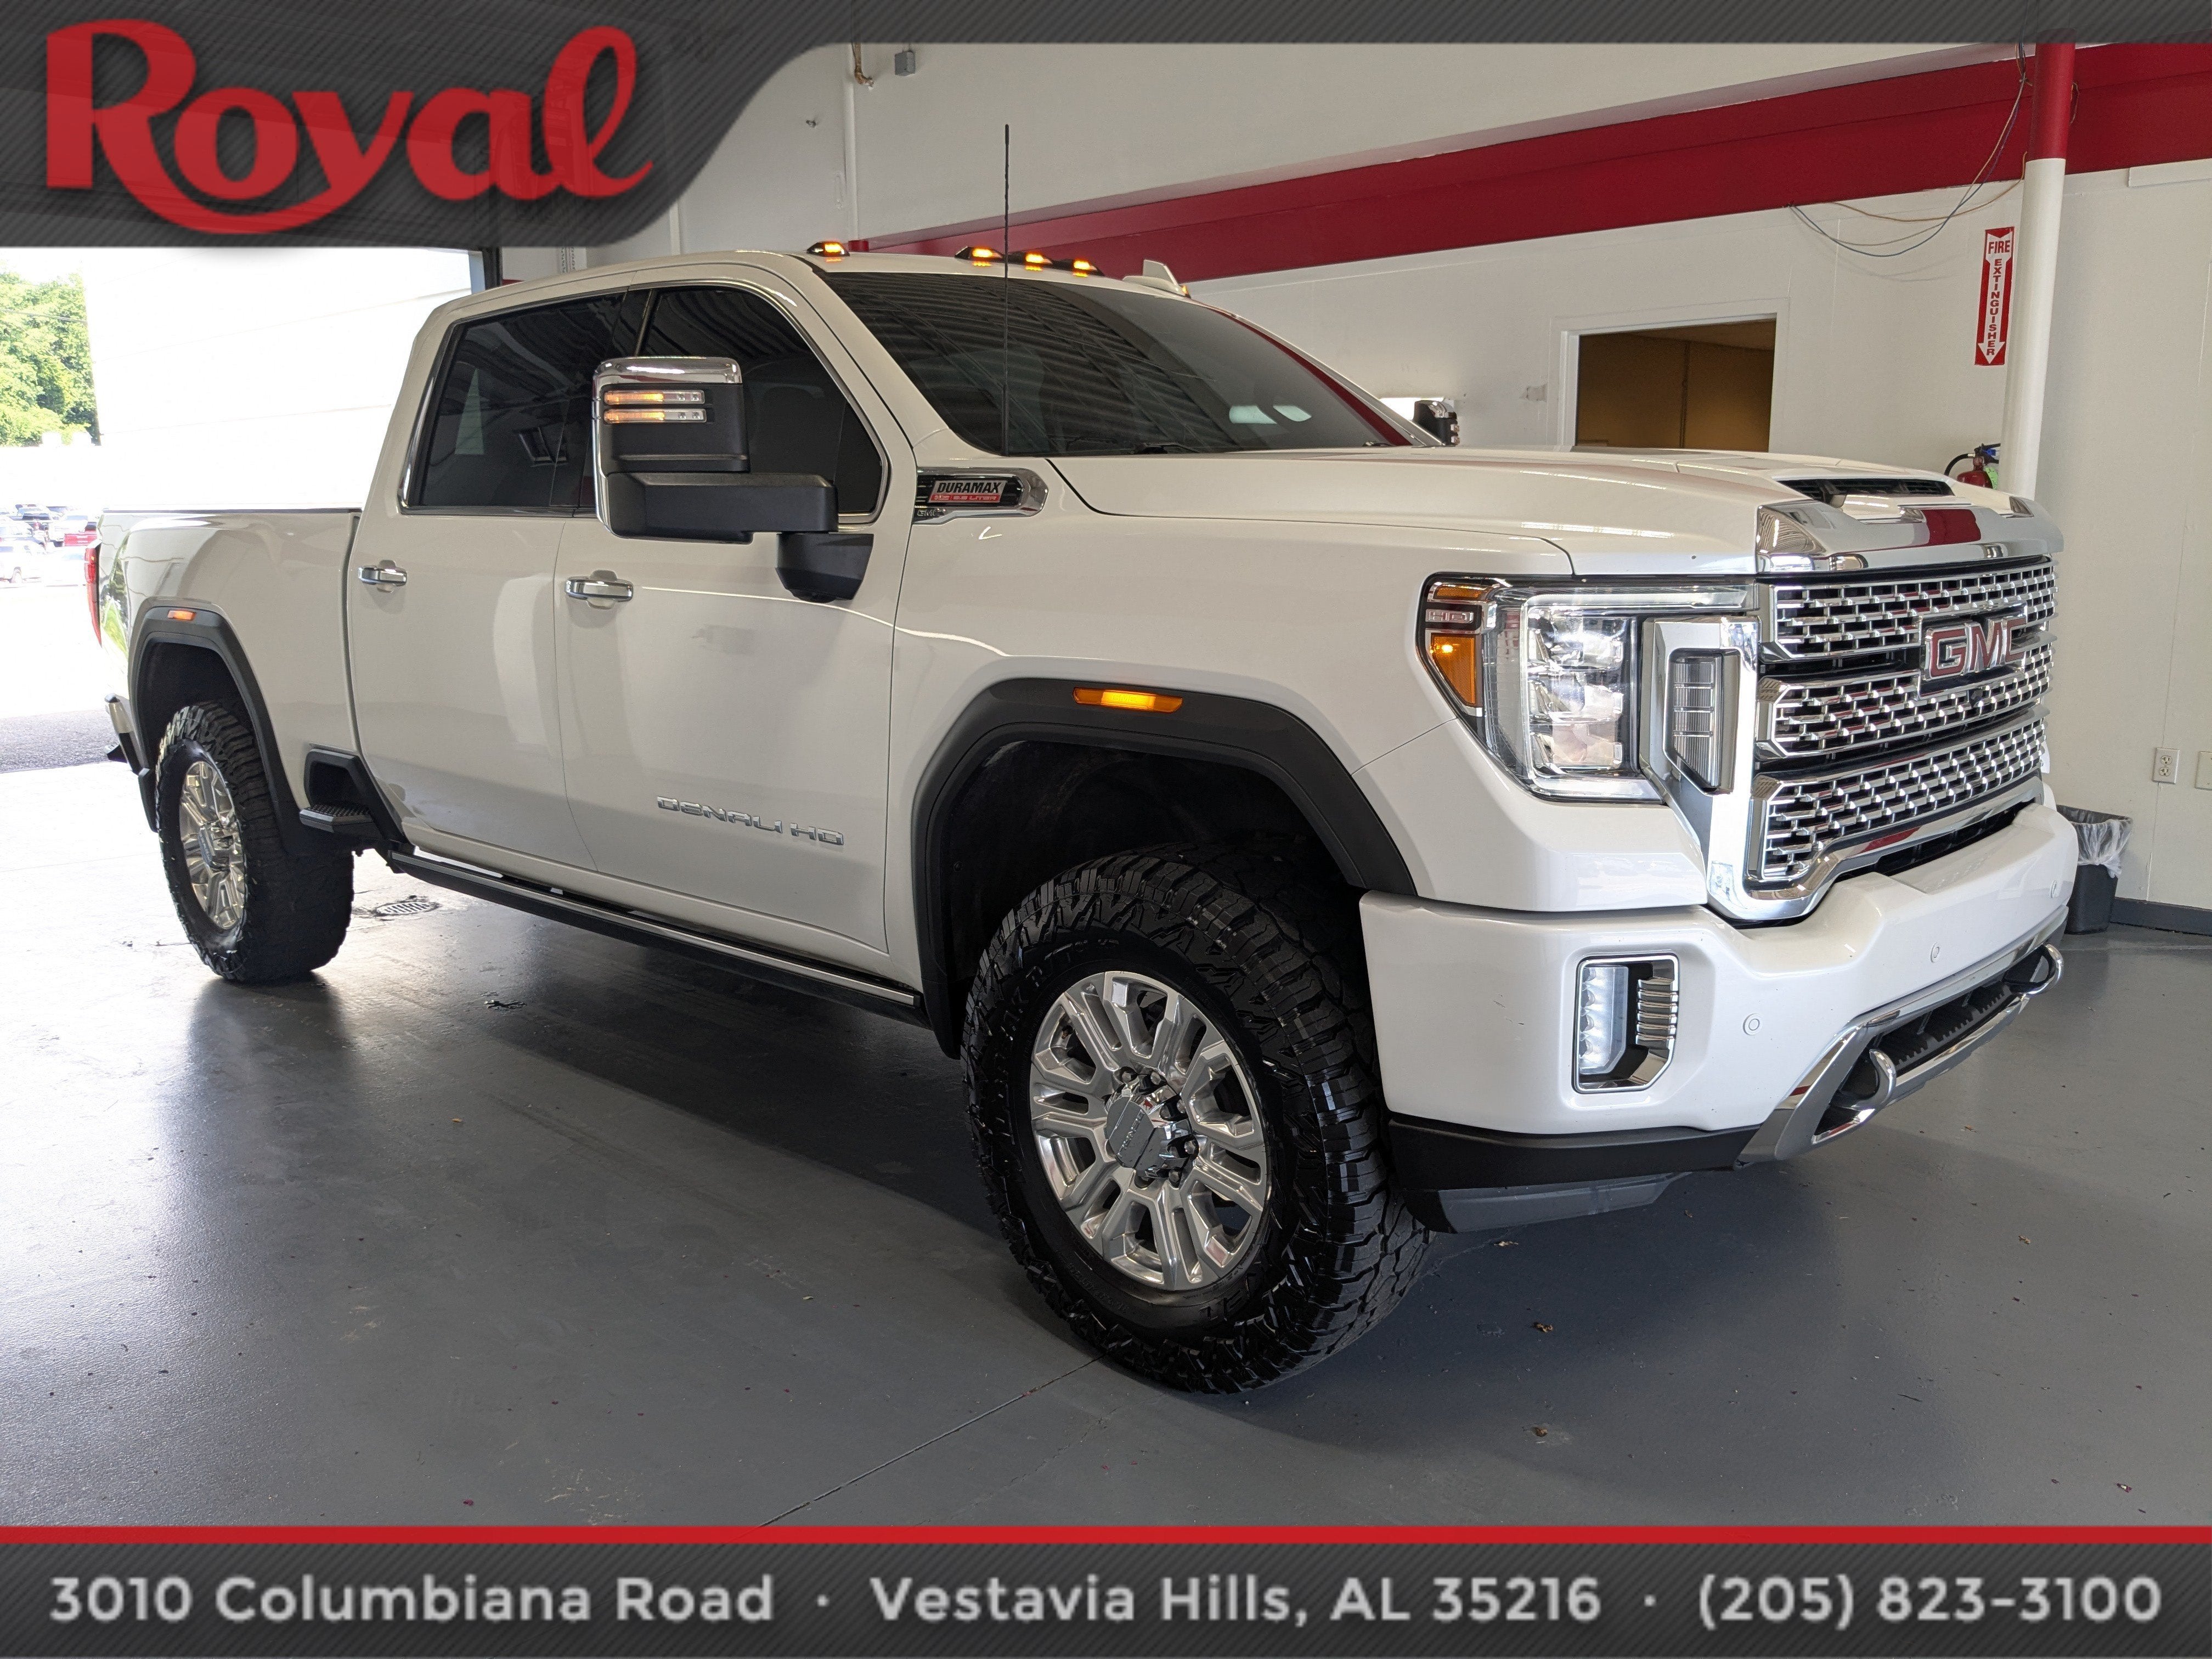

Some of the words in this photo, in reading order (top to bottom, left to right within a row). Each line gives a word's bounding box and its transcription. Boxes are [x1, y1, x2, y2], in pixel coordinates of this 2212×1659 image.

[1988, 240, 2011, 254] FIRE
[1986, 258, 2003, 356] EXTINGUISHER
[936, 482, 1002, 494] DURAMAX
[1925, 616, 2027, 680] GMC
[656, 795, 783, 834] DENALI
[790, 822, 844, 846] HD
